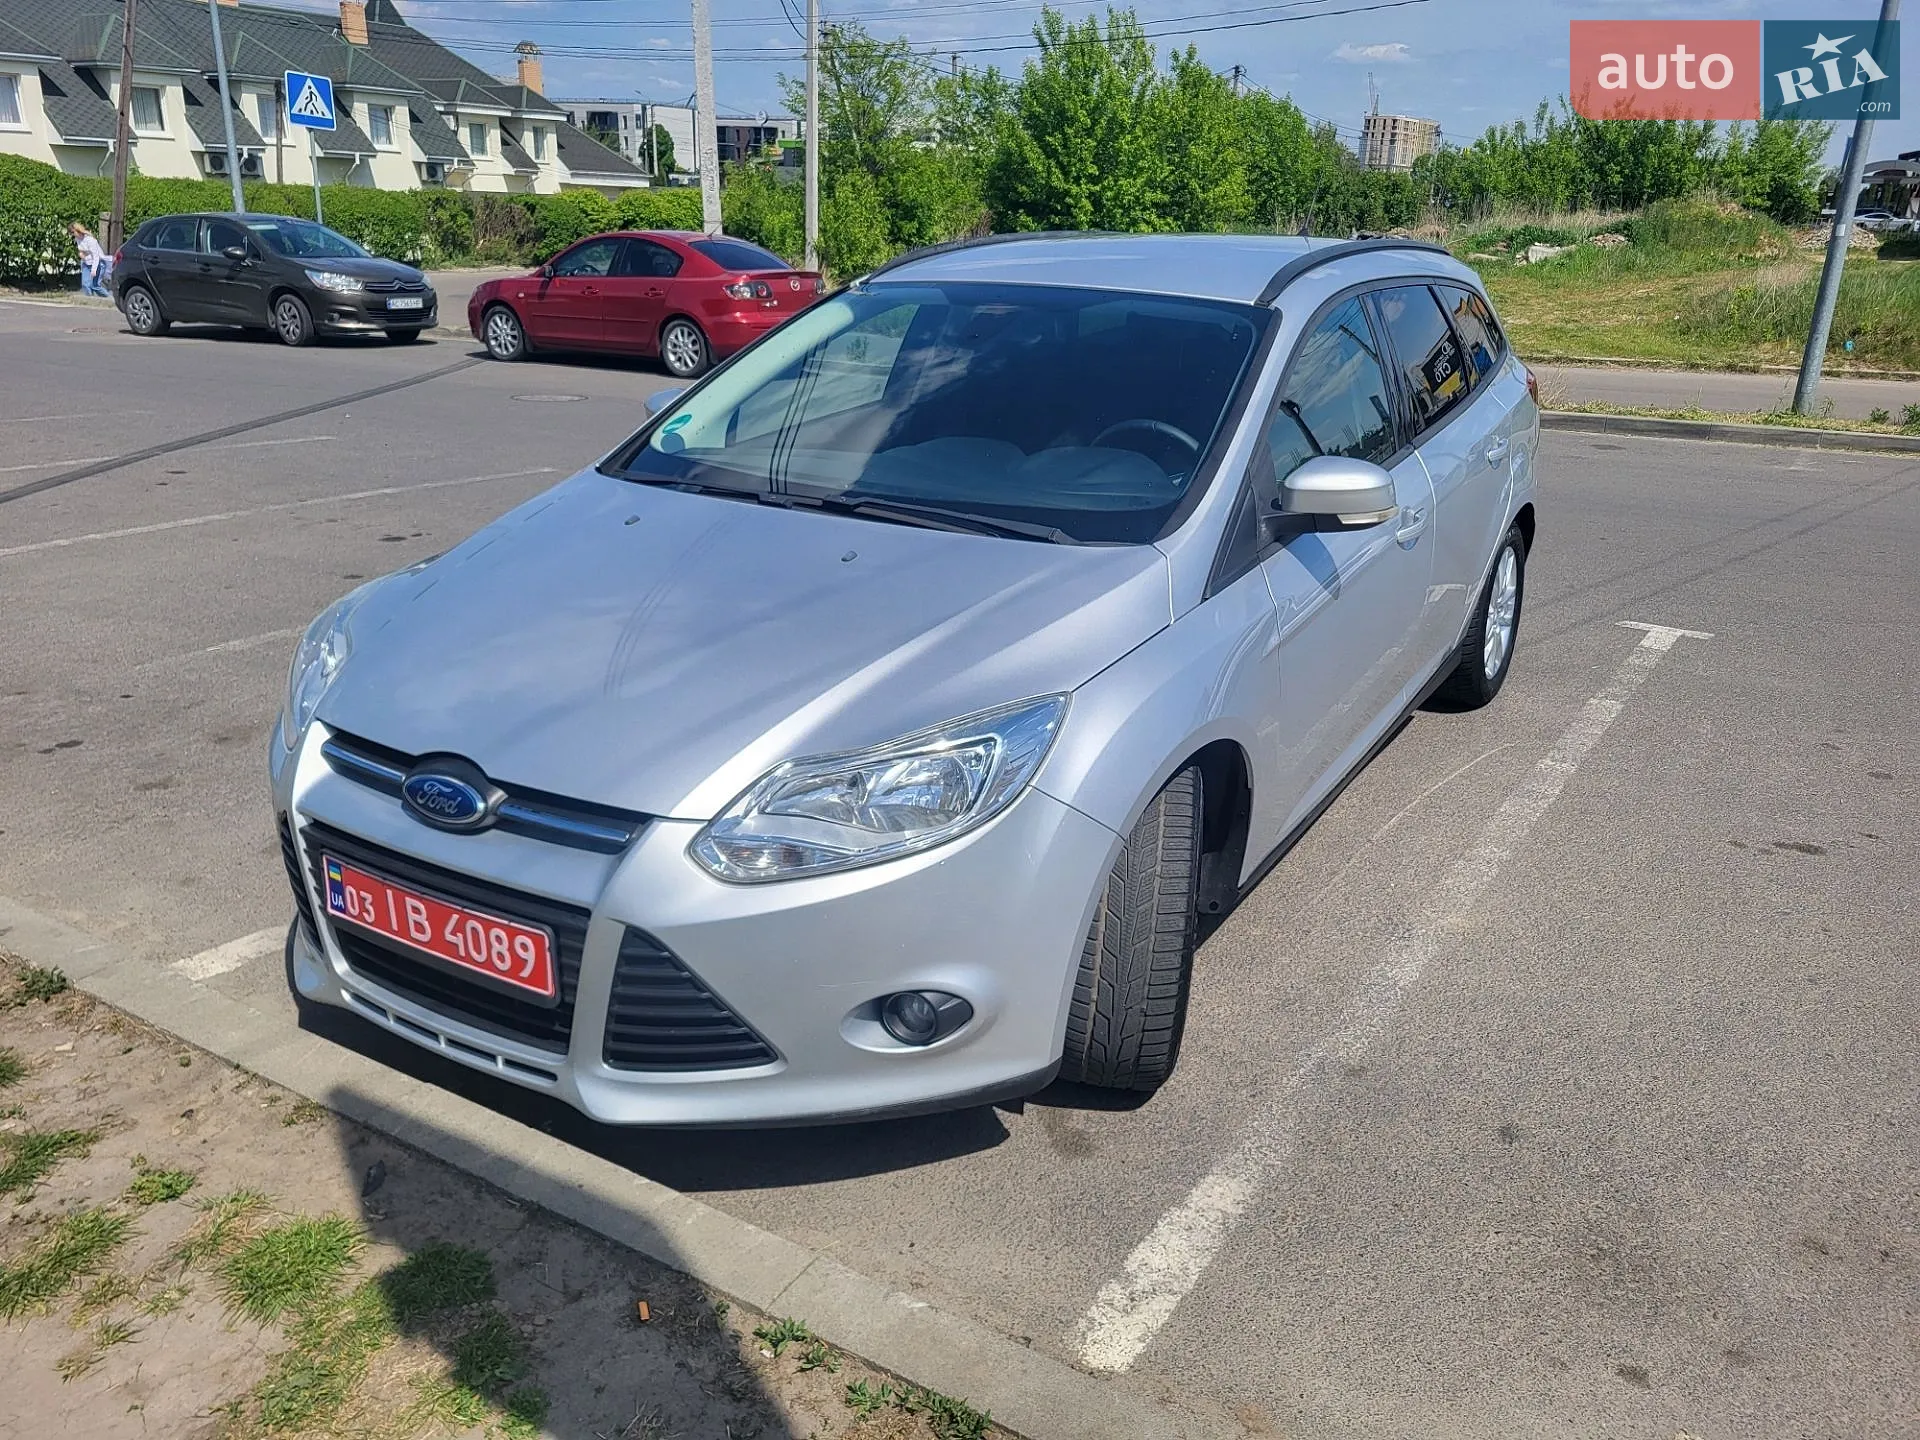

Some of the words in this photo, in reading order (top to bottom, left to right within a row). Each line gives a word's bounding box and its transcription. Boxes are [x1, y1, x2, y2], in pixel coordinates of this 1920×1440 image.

[416, 781, 462, 814] Ford
[331, 892, 345, 909] UA
[345, 885, 375, 923] 03
[386, 889, 432, 943] IB
[444, 914, 536, 979] 4089
